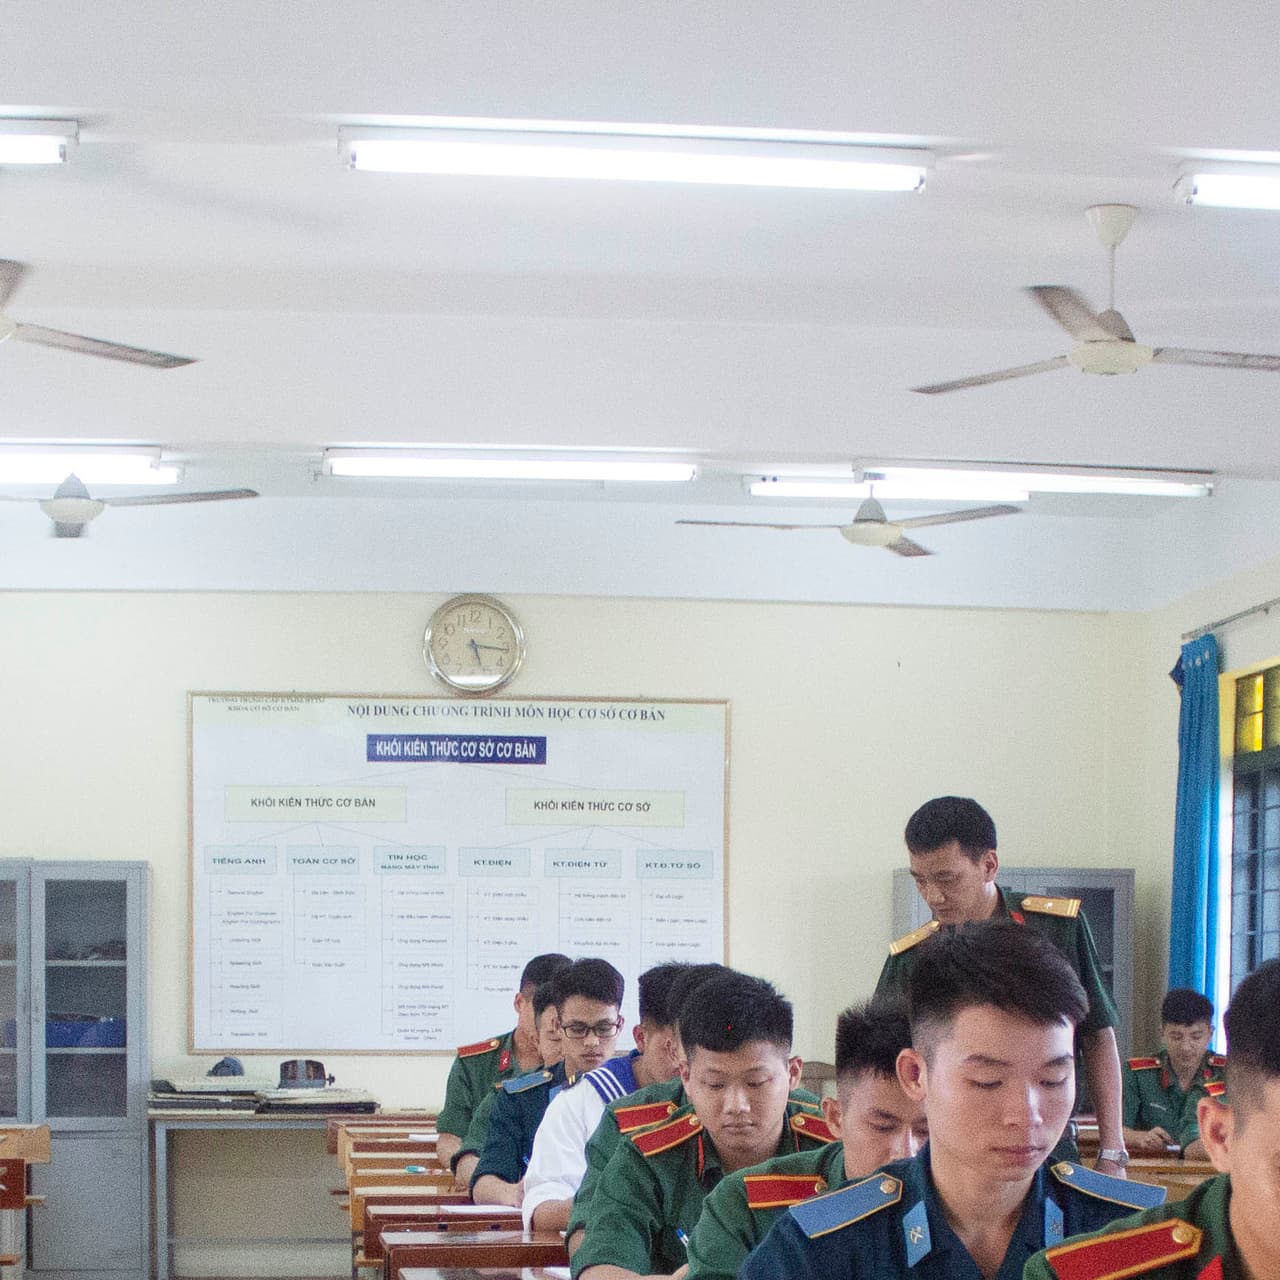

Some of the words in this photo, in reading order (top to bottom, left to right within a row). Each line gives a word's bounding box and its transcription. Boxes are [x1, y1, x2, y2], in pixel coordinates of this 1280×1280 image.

[470, 610, 481, 623] 12
[374, 705, 409, 717] DUNG
[472, 703, 511, 718] TRÌNH
[515, 703, 545, 719] MÔN
[548, 706, 575, 722] HỌC
[376, 739, 402, 756] KHỐI
[404, 738, 428, 757] KIẾN
[430, 737, 459, 757] THỨC
[461, 741, 478, 757] CƠ
[479, 740, 496, 758] SỞ
[496, 742, 513, 758] CƠ
[515, 740, 537, 759] BẢN
[244, 857, 266, 865] ANH
